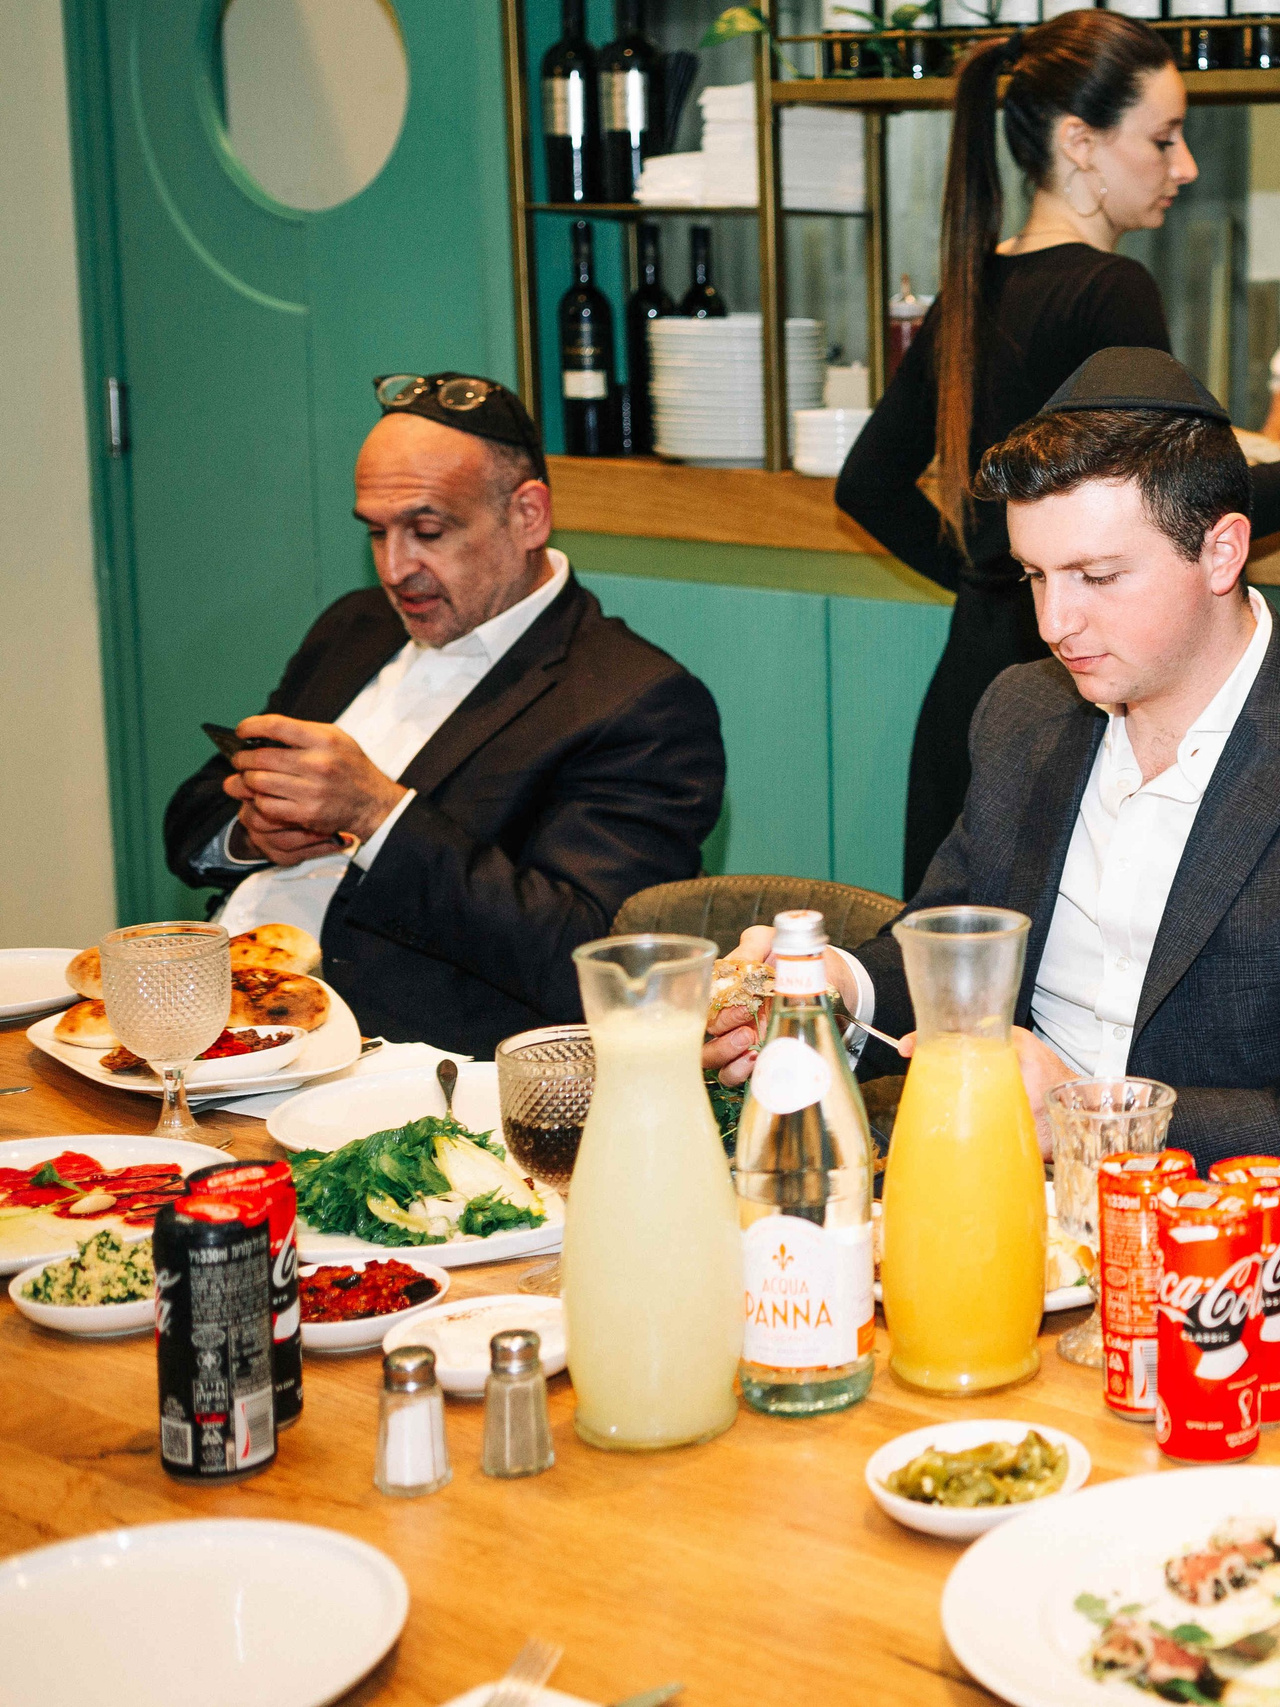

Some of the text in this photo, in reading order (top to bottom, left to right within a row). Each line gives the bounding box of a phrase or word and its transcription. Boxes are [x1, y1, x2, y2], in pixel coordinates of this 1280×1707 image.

[762, 1277, 809, 1295] ACQUA
[744, 1289, 833, 1330] PANNA
[1105, 1331, 1131, 1352] Coke
[1180, 1330, 1231, 1343] CLASSIC
